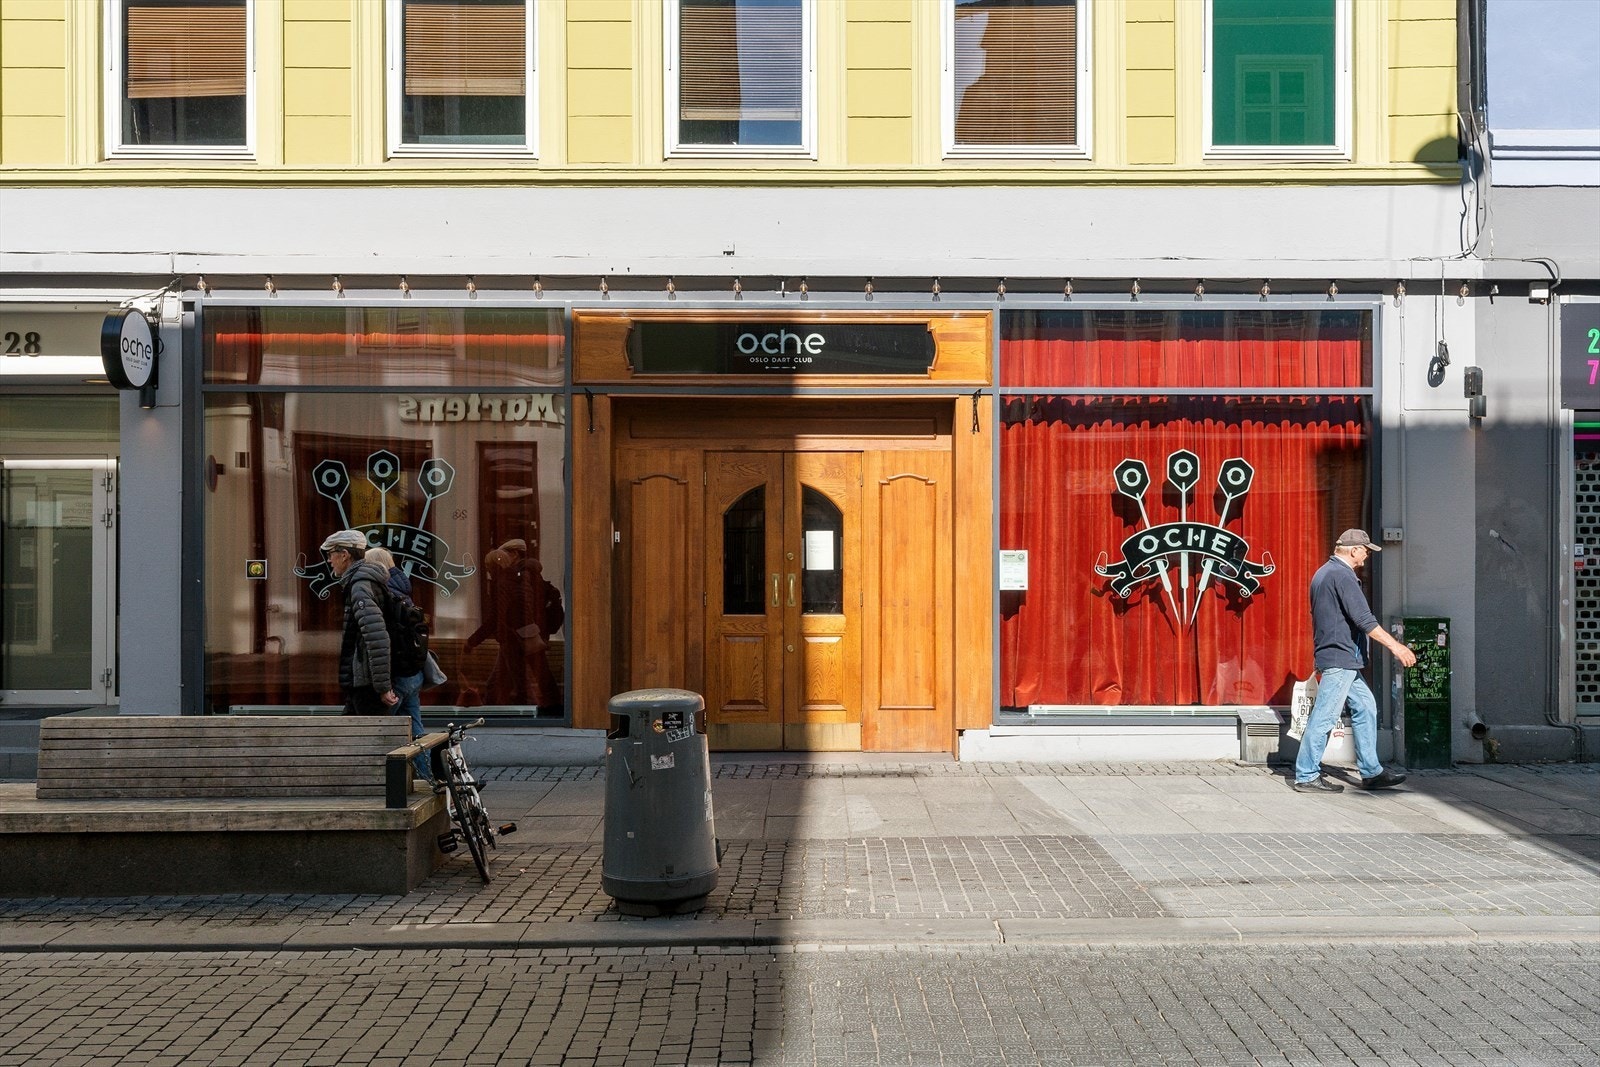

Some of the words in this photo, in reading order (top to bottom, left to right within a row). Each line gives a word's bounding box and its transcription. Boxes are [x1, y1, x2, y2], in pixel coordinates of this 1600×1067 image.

[0, 331, 42, 357] 28
[122, 337, 152, 360] oche
[736, 329, 826, 354] oche
[364, 527, 432, 556] CHE
[1138, 527, 1232, 556] OCHE
